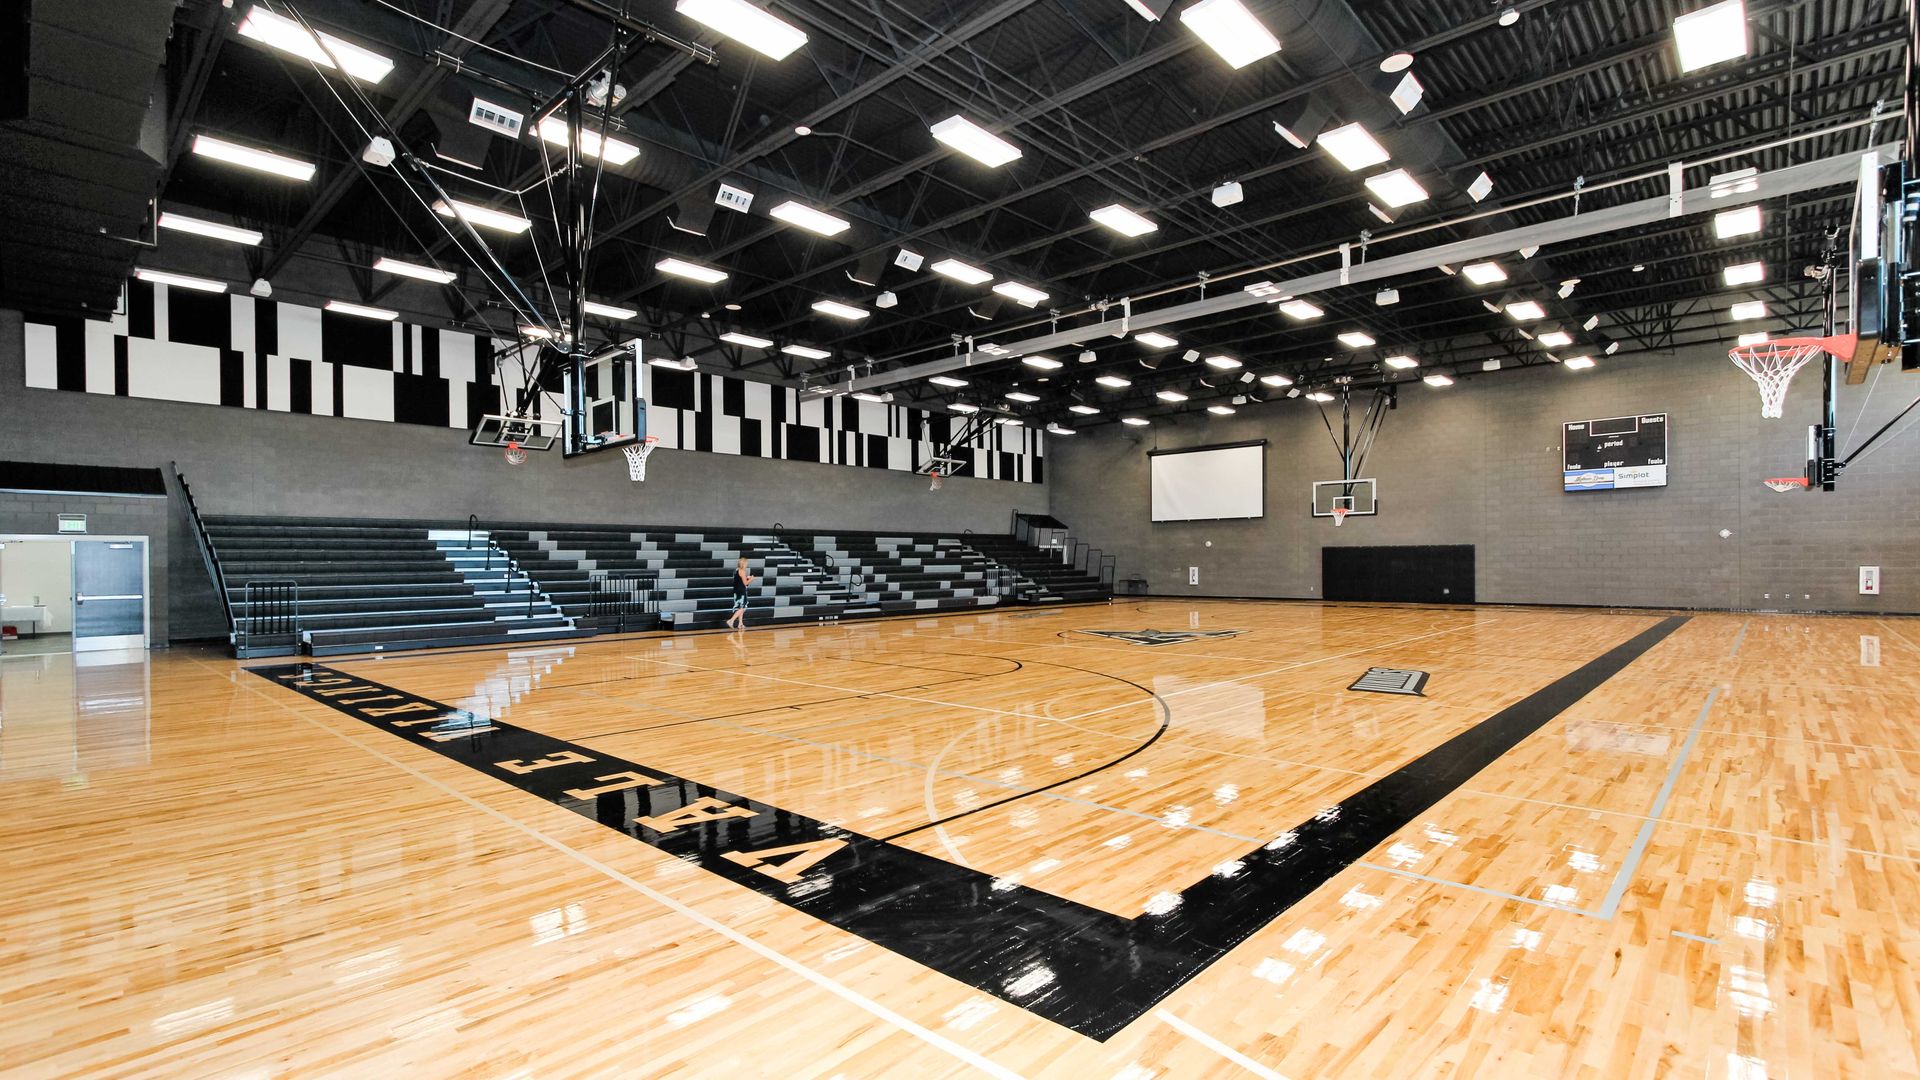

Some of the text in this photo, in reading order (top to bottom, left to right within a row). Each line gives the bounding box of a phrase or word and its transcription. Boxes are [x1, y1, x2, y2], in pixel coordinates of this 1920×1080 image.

[1603, 440, 1624, 448] period
[1603, 460, 1624, 468] player
[1617, 472, 1650, 480] Simplot
[494, 750, 849, 884] VALE
